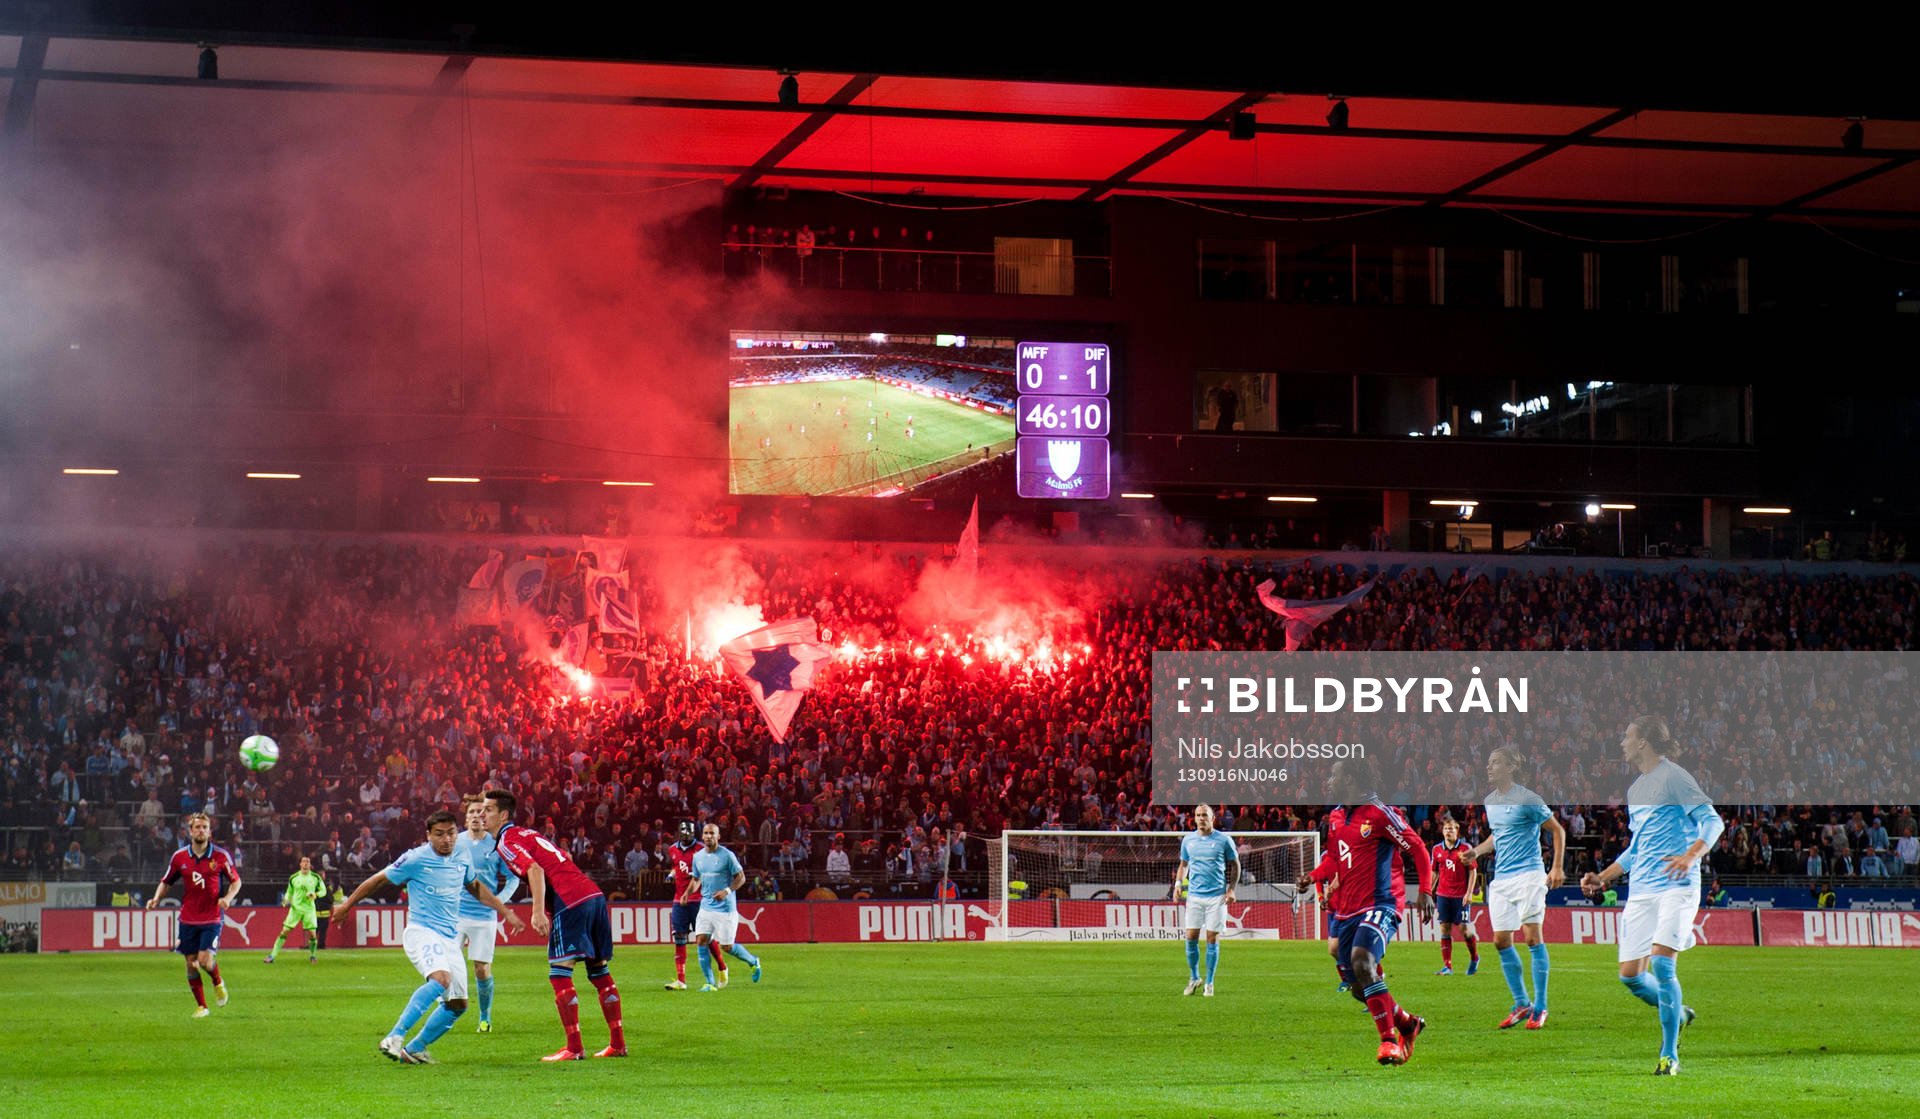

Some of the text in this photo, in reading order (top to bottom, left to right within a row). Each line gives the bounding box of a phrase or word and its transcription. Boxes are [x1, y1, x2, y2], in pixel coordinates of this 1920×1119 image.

[1022, 346, 1106, 361] MFF DIF
[1026, 363, 1043, 389] 0
[1086, 364, 1097, 390] 1
[1025, 403, 1102, 430] 46:10
[1045, 476, 1083, 490] Malmö FF
[534, 836, 567, 863] 9
[92, 911, 181, 949] PUM
[355, 909, 409, 946] PU
[858, 903, 967, 941] PUMA
[1104, 904, 1187, 929] PUM
[1364, 910, 1383, 925] 11
[1802, 911, 1903, 947] PUMA
[1135, 929, 1155, 940] med
[422, 943, 444, 959] 20
